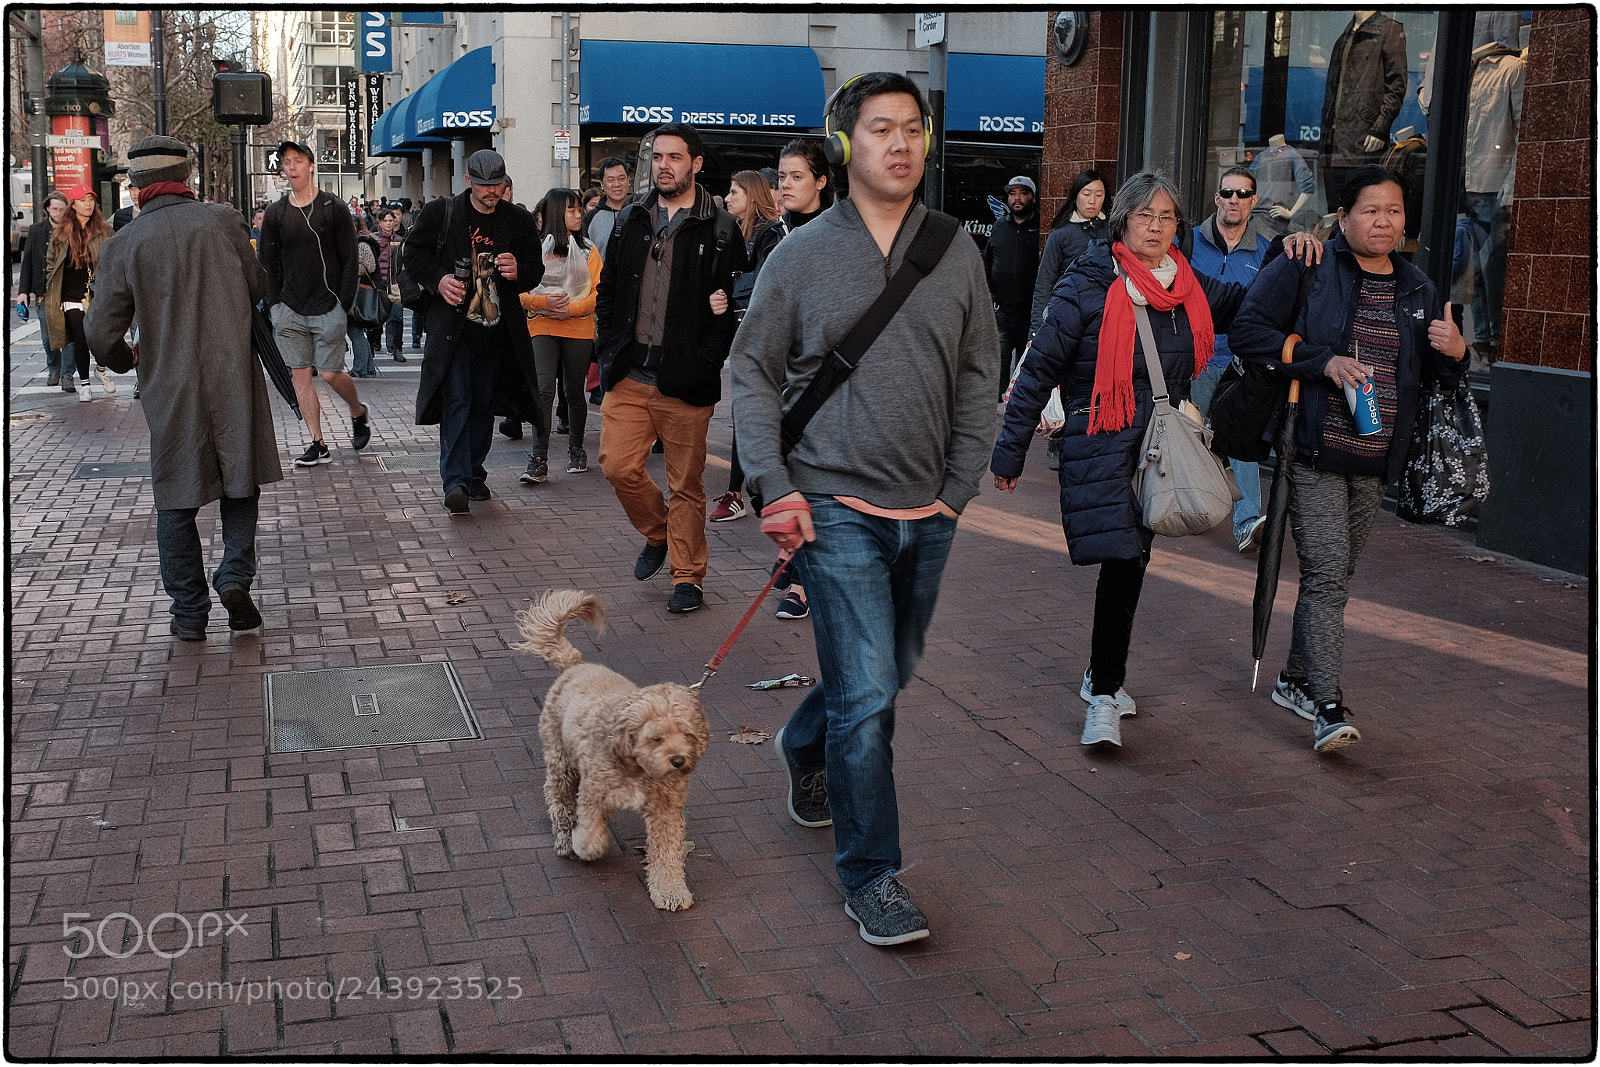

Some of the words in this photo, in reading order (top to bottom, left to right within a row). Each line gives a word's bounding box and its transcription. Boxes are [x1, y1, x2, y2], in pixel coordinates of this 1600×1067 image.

[442, 110, 493, 128] ROSS
[622, 105, 674, 123] ROSS
[681, 111, 725, 125] DRESS
[729, 113, 757, 125] FOR
[762, 114, 796, 126] LESS
[979, 116, 1025, 133] ROSS
[58, 138, 75, 146] 4TH
[80, 138, 90, 146] ST
[348, 110, 357, 165] WEARHOUSE
[963, 220, 993, 237] King
[1365, 396, 1379, 426] pepsi
